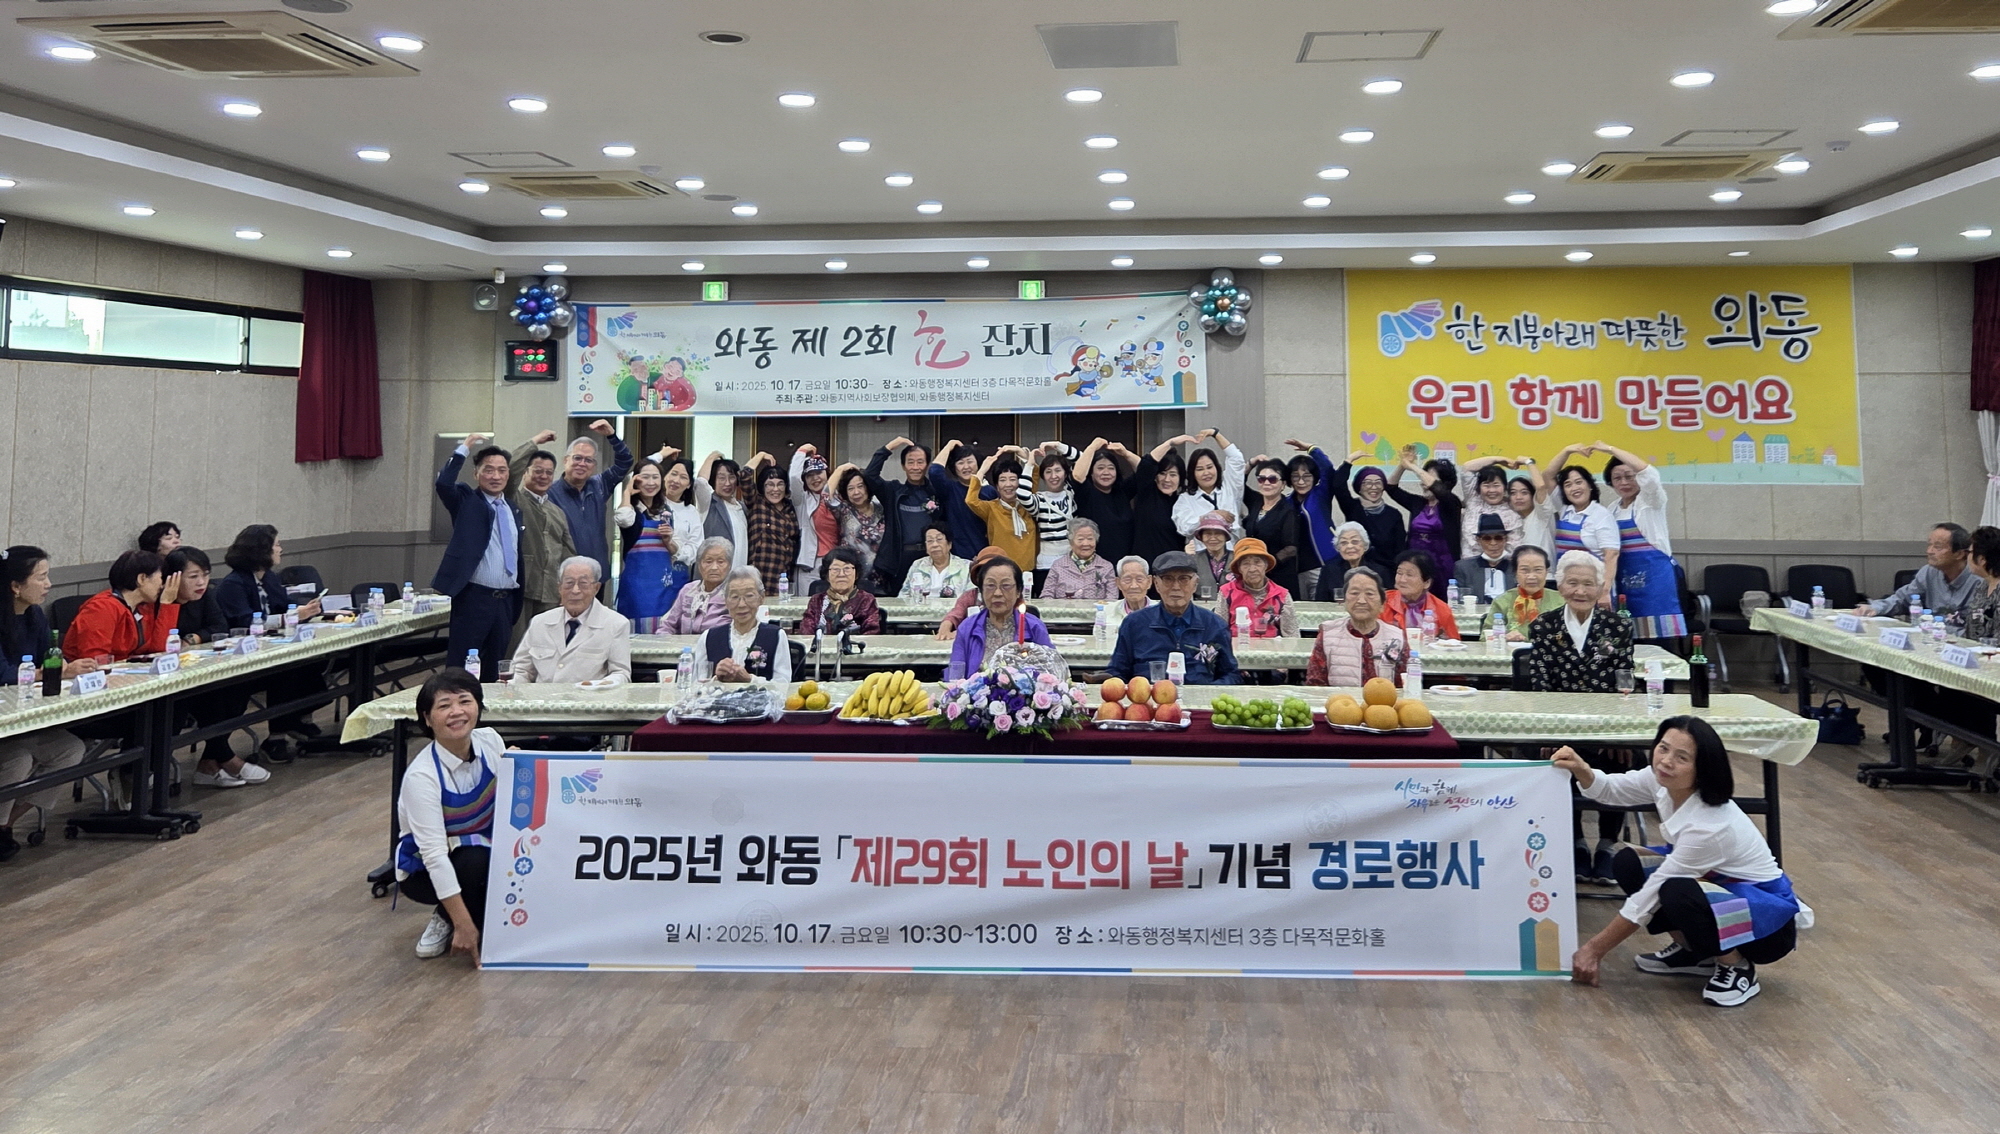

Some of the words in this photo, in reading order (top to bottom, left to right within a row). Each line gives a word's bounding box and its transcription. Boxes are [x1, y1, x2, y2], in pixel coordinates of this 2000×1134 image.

[1446, 303, 1484, 352] 한
[1493, 314, 1595, 351] 지붕아래
[1603, 312, 1686, 350] 따뜻한
[1706, 292, 1820, 360] 와동
[714, 326, 778, 369] 와동
[791, 326, 830, 357] 제
[839, 324, 898, 358] 2회
[981, 322, 1052, 357] 잔치
[804, 379, 831, 390] 금요일
[835, 378, 875, 390] 10:30~
[909, 378, 980, 389] 와동행정복지센터
[981, 377, 997, 388] 3층
[998, 376, 1052, 387] 다목적문화홀
[919, 391, 990, 402] 와동행정복지센터
[1410, 377, 1491, 427] 우리
[1510, 376, 1599, 426] 함께
[1619, 377, 1793, 428] 만들어요
[1394, 777, 1431, 799] 시민과
[1486, 795, 1519, 809] 안산
[574, 834, 723, 884] 2025년
[736, 834, 821, 886] 와동
[1002, 839, 1131, 890] 노인의
[1208, 842, 1292, 889] 기념
[1307, 839, 1485, 891] 경로행사
[716, 925, 768, 943] 2025.
[840, 926, 890, 944] 금요일
[899, 924, 1038, 945] 10:30~13:00
[1107, 926, 1244, 946] 와동행정복지센터
[1249, 926, 1279, 946] 3층
[1282, 927, 1386, 948] 다목적문화홀
